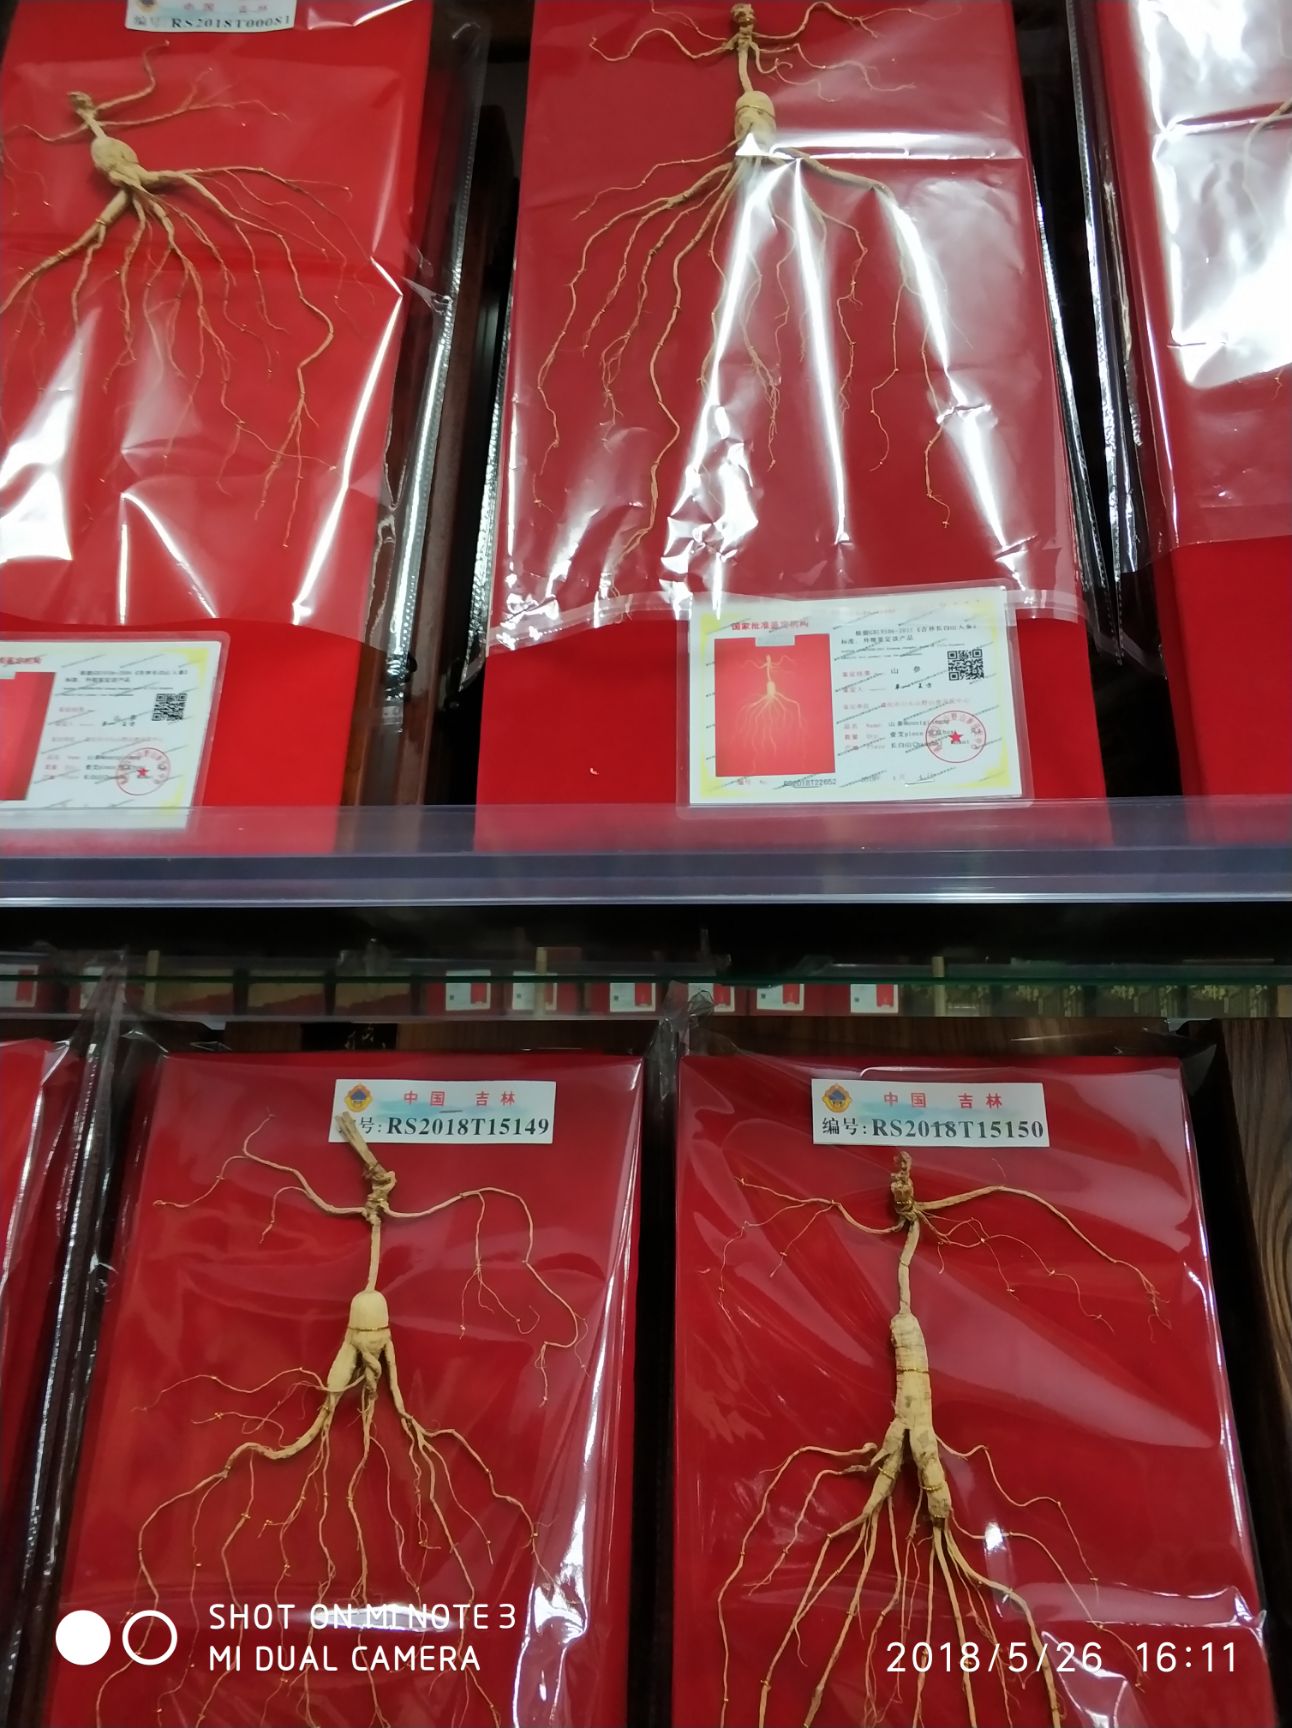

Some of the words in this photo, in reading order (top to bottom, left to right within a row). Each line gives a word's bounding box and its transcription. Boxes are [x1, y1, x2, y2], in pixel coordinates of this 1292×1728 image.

[403, 1089, 446, 1107] 中国
[475, 1090, 516, 1107] 吉林
[883, 1091, 927, 1109] 中国
[958, 1092, 1003, 1110] 吉林
[338, 1116, 550, 1136] 号:RS2018T15149
